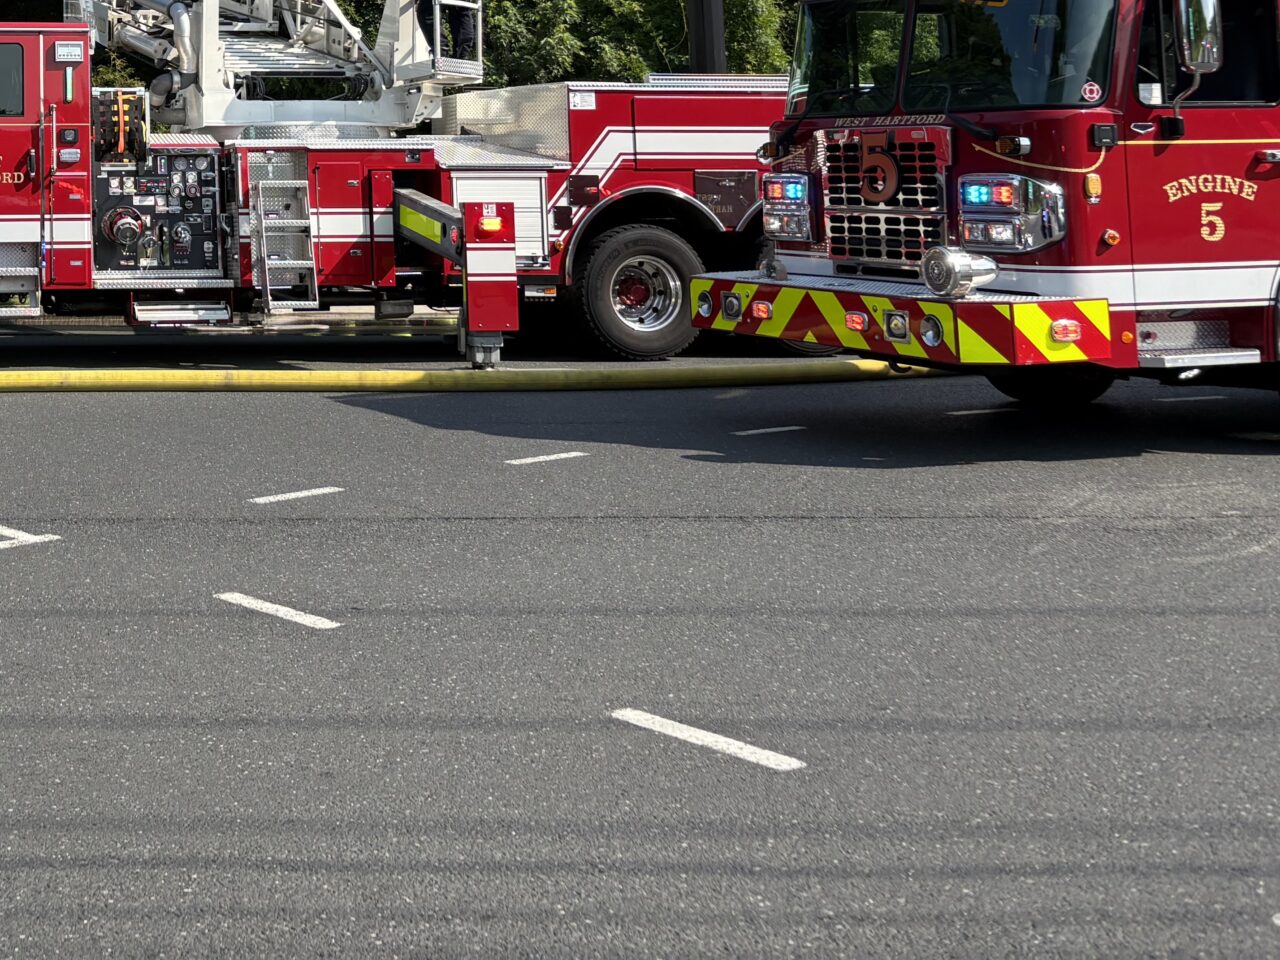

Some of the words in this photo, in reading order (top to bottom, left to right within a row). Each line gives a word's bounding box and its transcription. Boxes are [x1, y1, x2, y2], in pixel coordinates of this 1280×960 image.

[834, 117, 869, 127] WEST
[873, 114, 946, 126] HARTFORD
[860, 131, 899, 203] 5
[1162, 174, 1258, 202] ENGINE
[1200, 202, 1226, 241] 5
